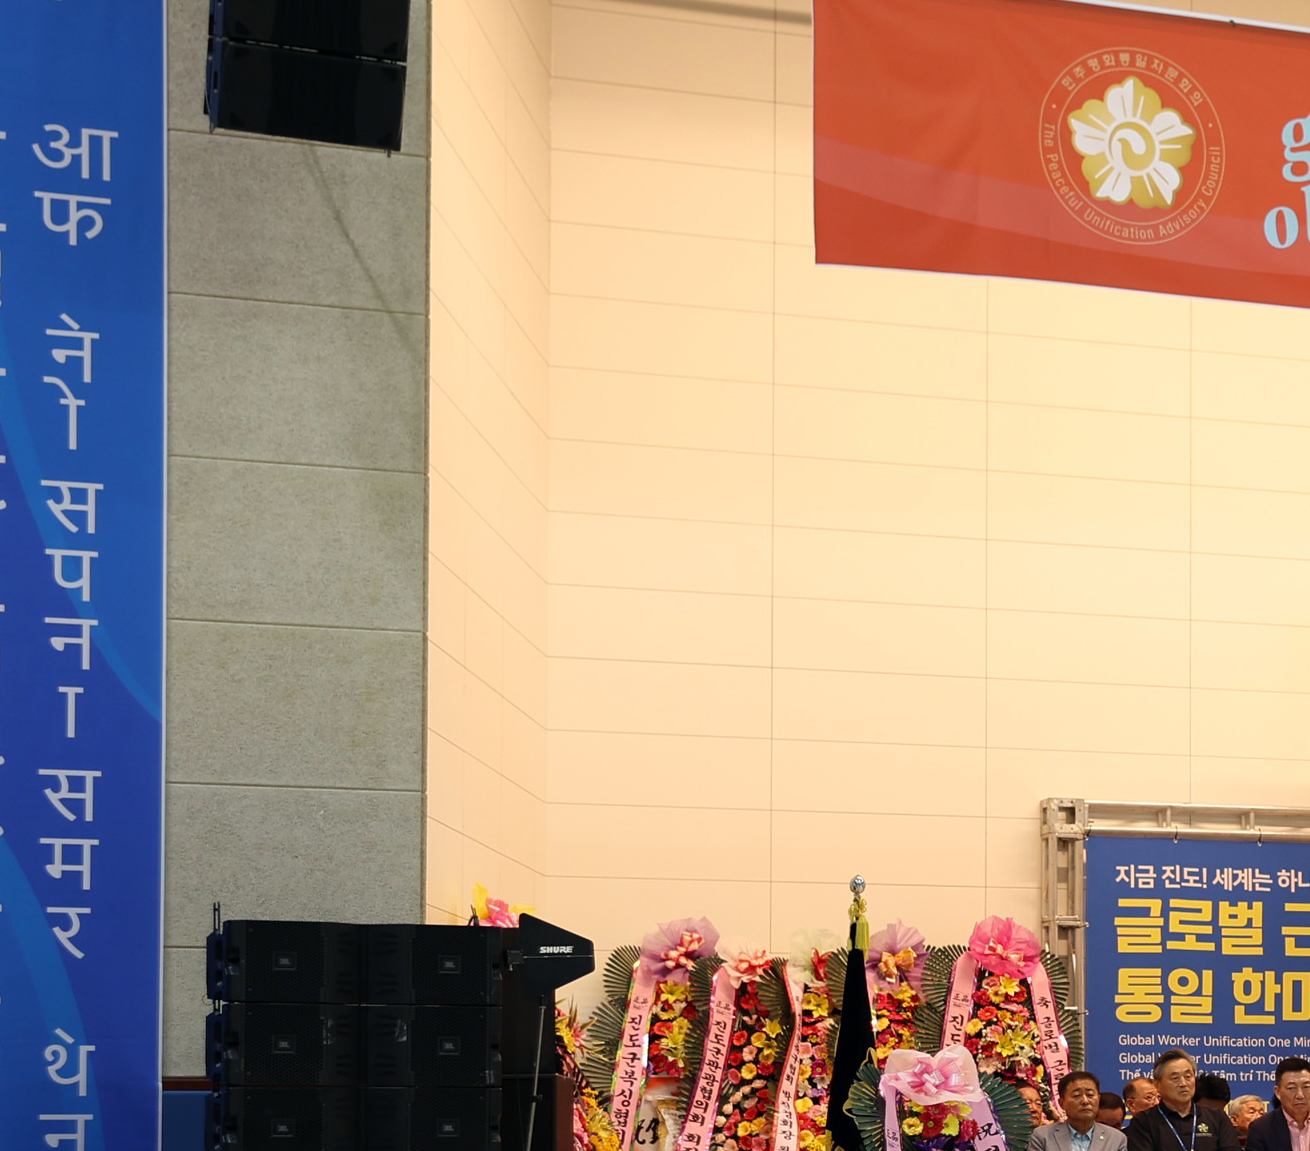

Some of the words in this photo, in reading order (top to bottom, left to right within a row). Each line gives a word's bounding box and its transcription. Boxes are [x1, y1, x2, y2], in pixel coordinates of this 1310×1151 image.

[1044, 122, 1056, 147] The
[1046, 153, 1084, 211] Peaceful
[1202, 146, 1221, 196] Council
[1084, 207, 1155, 240] Unification
[1159, 198, 1208, 237] Advisory
[1115, 864, 1157, 889] 지금
[1162, 865, 1208, 890] 진도!
[1212, 867, 1273, 892] 세계는
[1114, 898, 1264, 956] 글로벌
[539, 945, 574, 954] SHURE
[1114, 967, 1214, 1024] 통일
[1118, 1034, 1156, 1047] Global
[1158, 1034, 1201, 1047] Worker
[1203, 1035, 1266, 1048] Unification
[1268, 1036, 1292, 1048] One
[1119, 1052, 1156, 1065] Global
[1203, 1053, 1266, 1066] Unification
